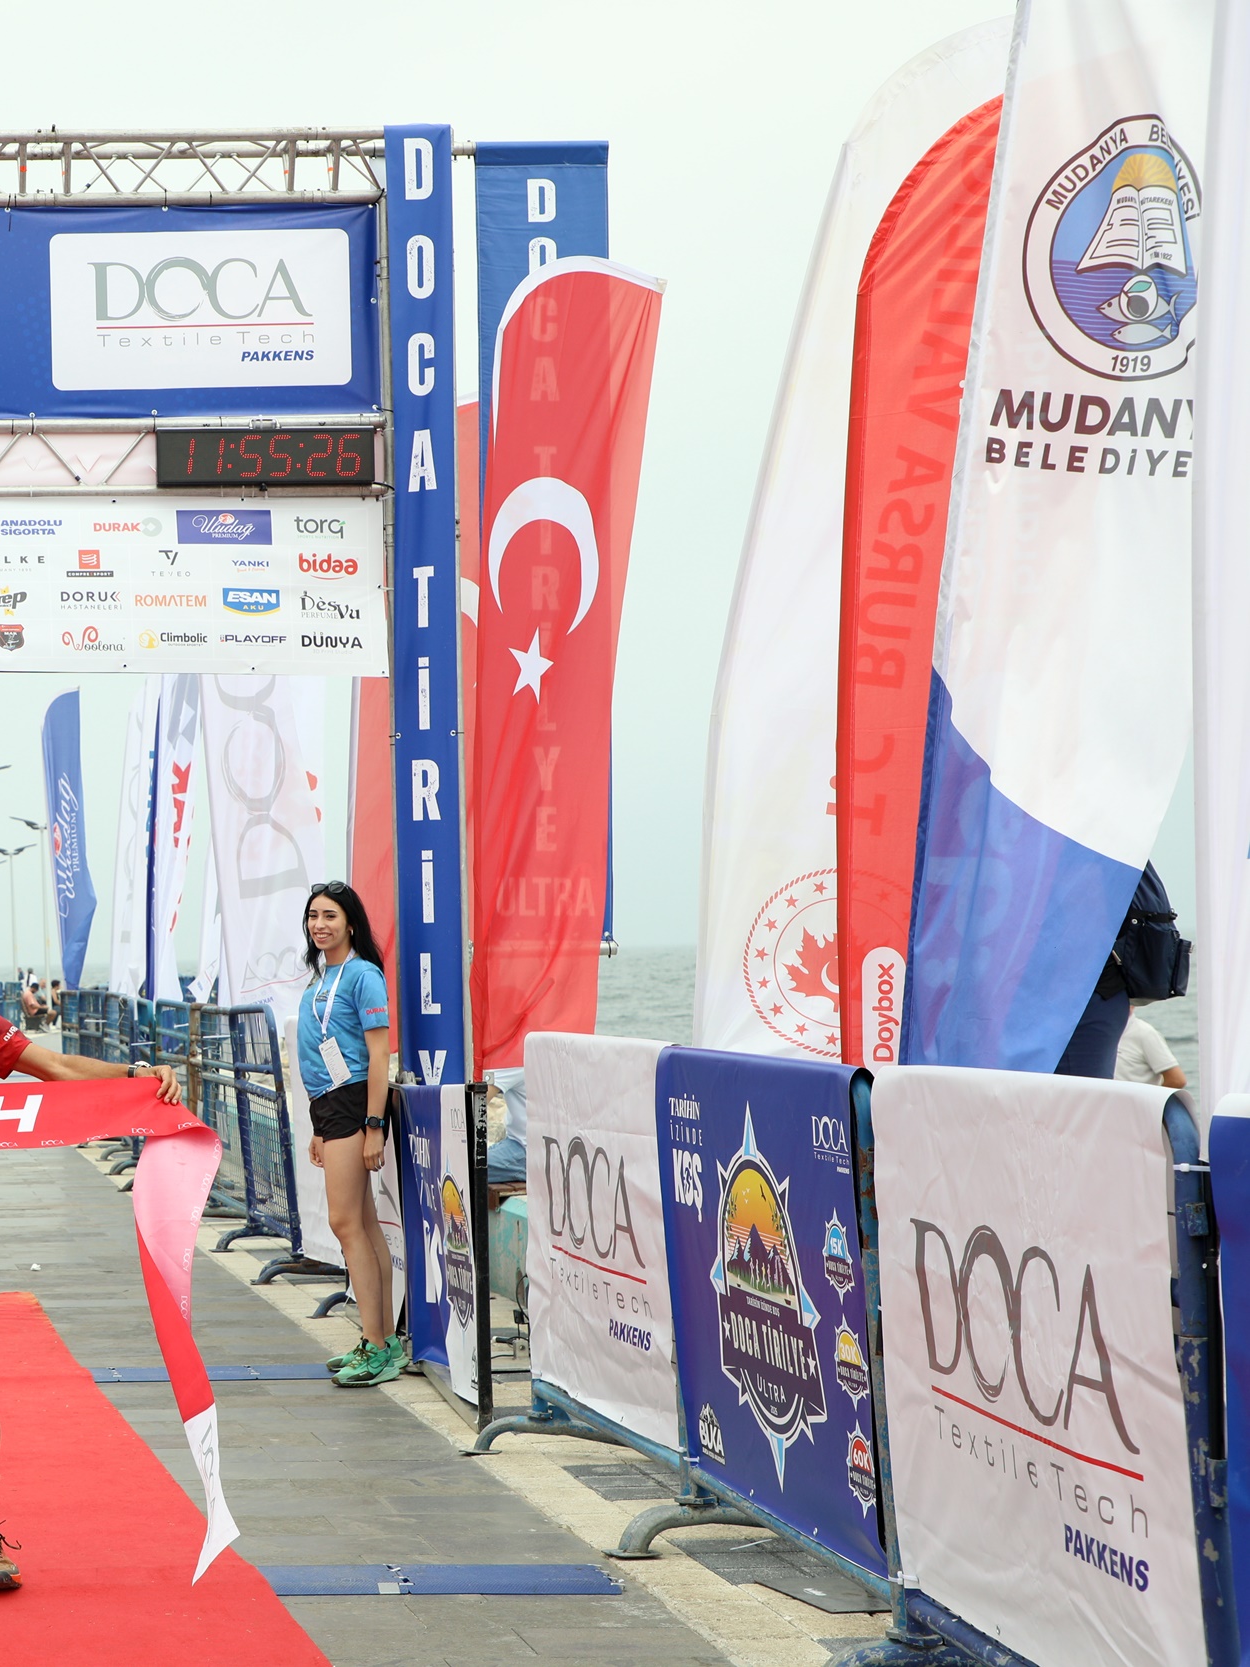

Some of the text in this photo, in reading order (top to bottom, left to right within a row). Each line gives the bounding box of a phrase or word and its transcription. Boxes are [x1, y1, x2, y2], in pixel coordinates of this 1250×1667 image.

[1045, 128, 1129, 211] MUDANYA
[87, 256, 313, 321] DOCA
[403, 137, 437, 493] DOCA
[97, 330, 315, 348] Textile Tech
[240, 349, 315, 362] PAKKENS
[1110, 354, 1152, 375] 1919
[989, 388, 1193, 441] MUDAN
[186, 433, 362, 478] 11:55:26
[0, 527, 56, 535] SİGORTA
[93, 522, 141, 532] DURAK
[298, 553, 358, 575] bidaa
[60, 591, 120, 602] DORUK
[134, 595, 207, 607] ROMATEM
[227, 591, 276, 604] ESAN
[160, 632, 208, 643] Climbolic
[225, 635, 287, 644] PLAYOFF
[872, 962, 900, 1062] Doybox
[669, 1093, 700, 1121] TARİHİN
[670, 1119, 703, 1146] İZİNDE
[811, 1115, 849, 1152] DOCA
[672, 1148, 703, 1223] KOŞ
[543, 1136, 646, 1268] DOCA
[830, 1237, 843, 1257] 15K
[550, 1256, 654, 1320] Textile Tech
[608, 1318, 652, 1352] PAKKENS
[730, 1311, 808, 1381] DOCA TİRİLYE
[910, 1217, 1140, 1454] DOCA
[840, 1342, 858, 1364] 30K
[756, 1373, 787, 1403] ULTRA
[699, 1419, 725, 1457] BUKA
[853, 1448, 871, 1472] 60K
[934, 1406, 1150, 1540] Textile Tech
[1064, 1523, 1150, 1593] PAKKENS
